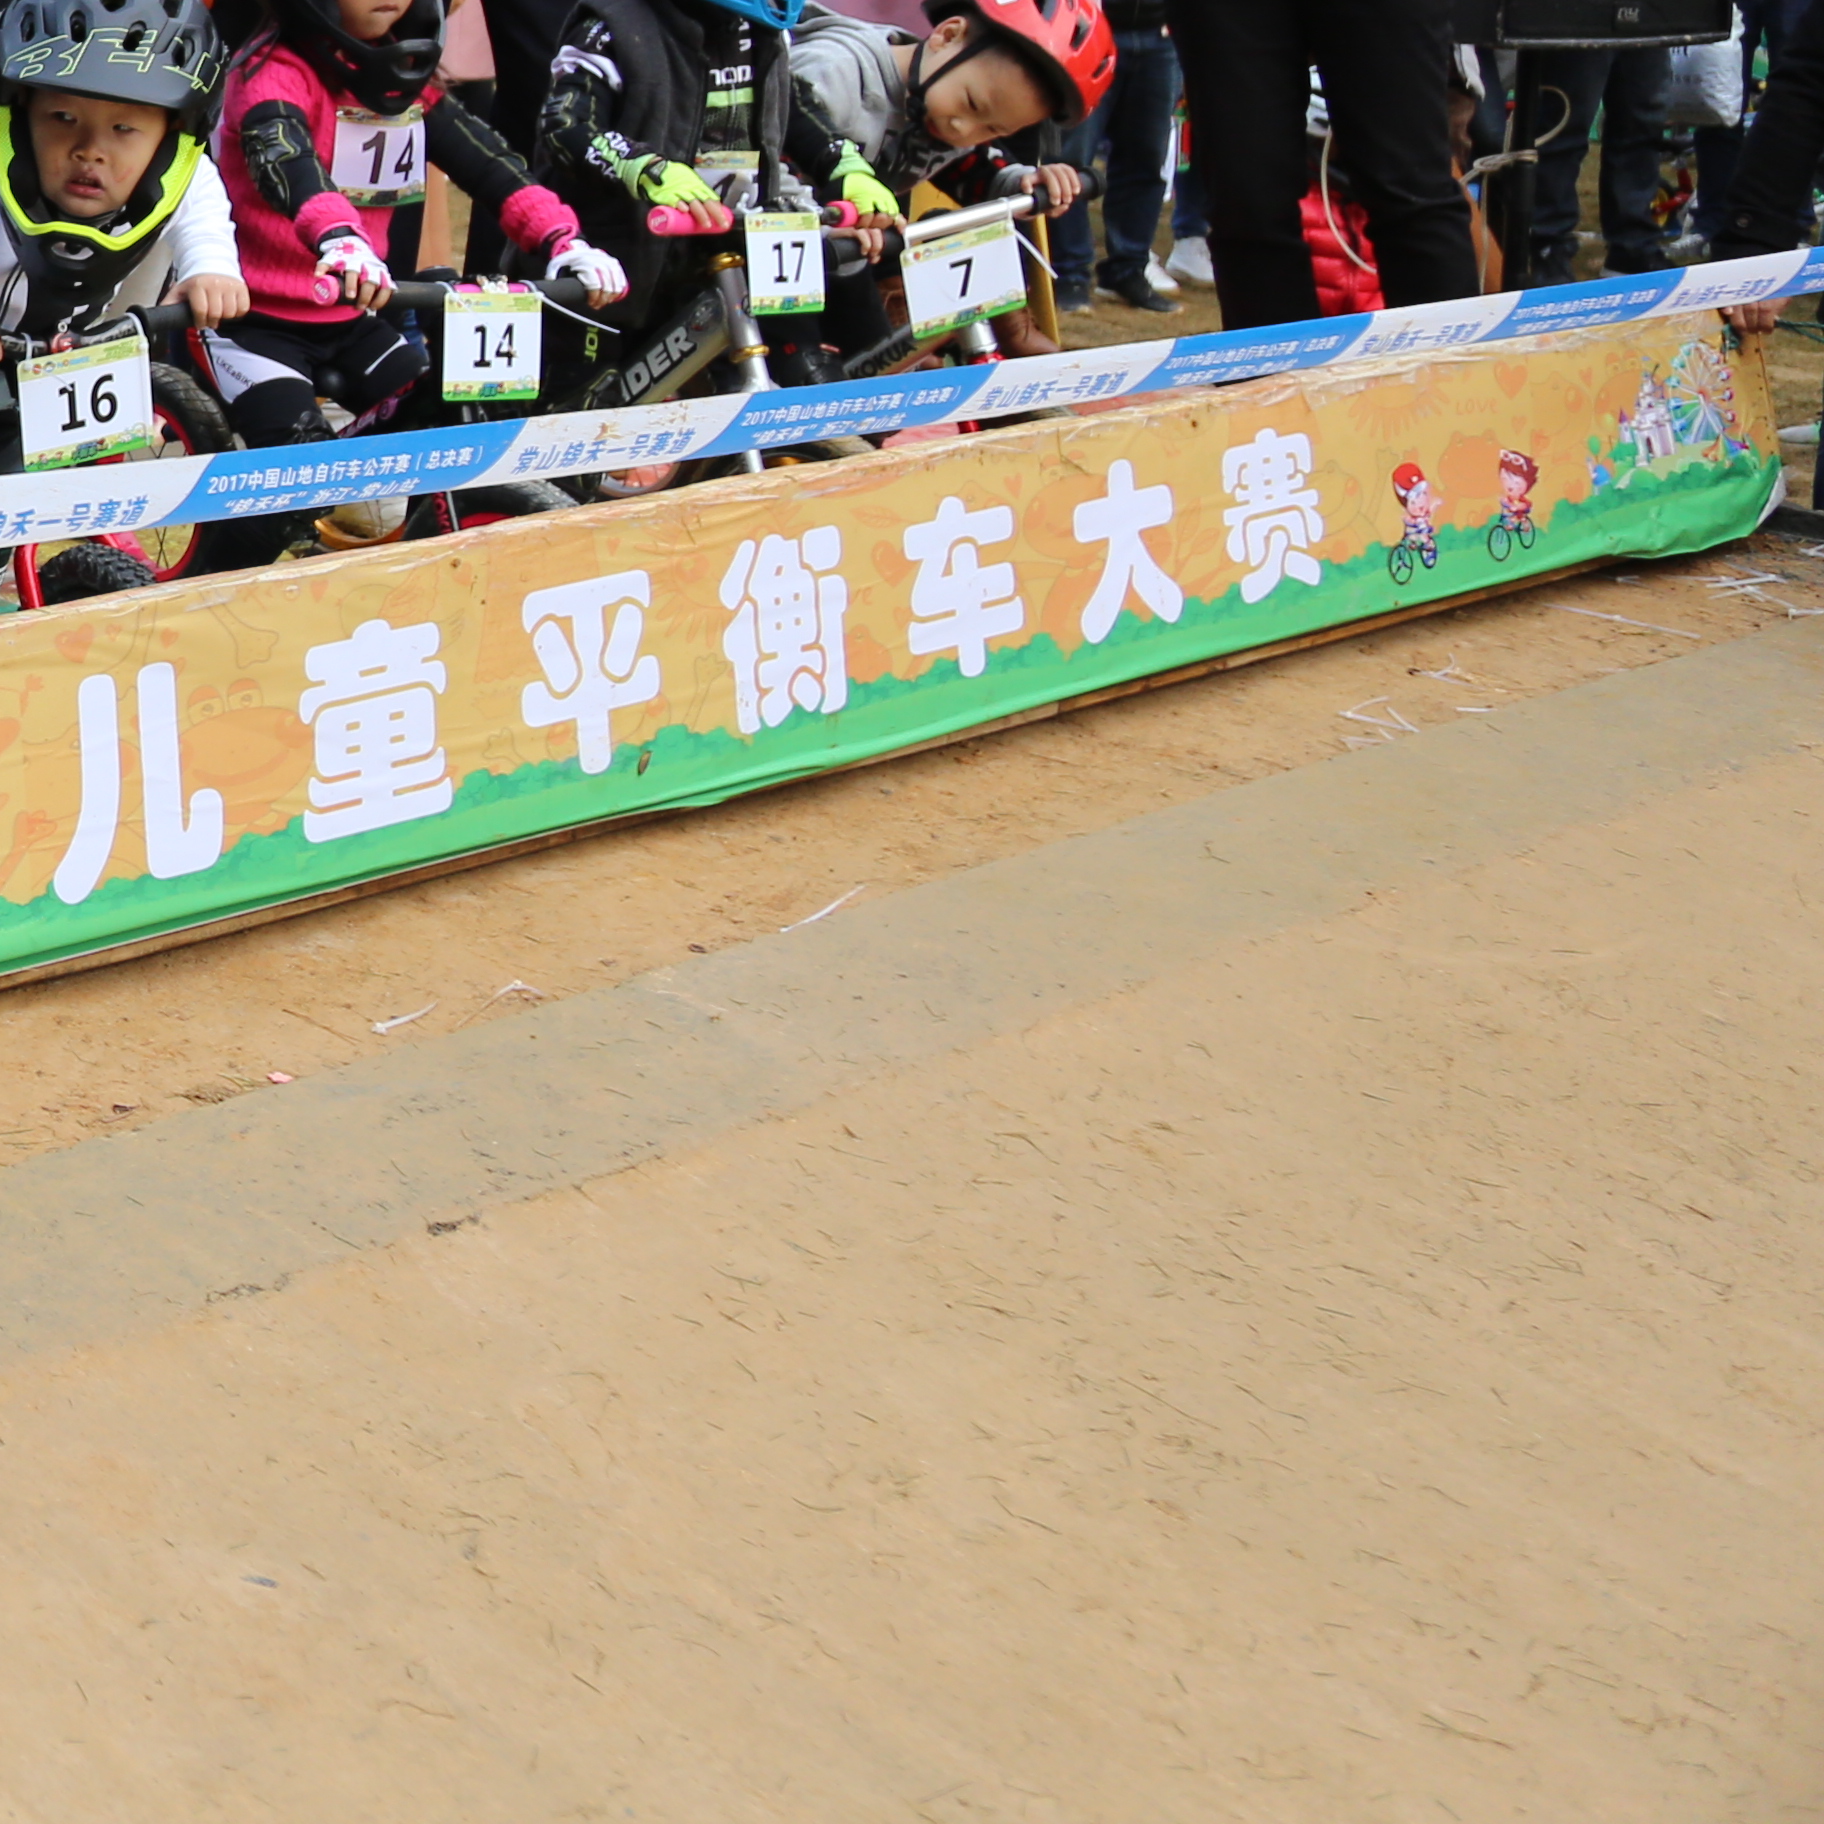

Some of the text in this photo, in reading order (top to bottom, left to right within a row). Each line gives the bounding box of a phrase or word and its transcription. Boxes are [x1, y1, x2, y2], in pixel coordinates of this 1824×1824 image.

[361, 128, 414, 185] 14
[772, 240, 807, 283] 17
[949, 256, 974, 299] 7
[473, 323, 518, 369] 14
[58, 373, 118, 433] 16
[509, 428, 697, 475] 常山锦禾一号赛道
